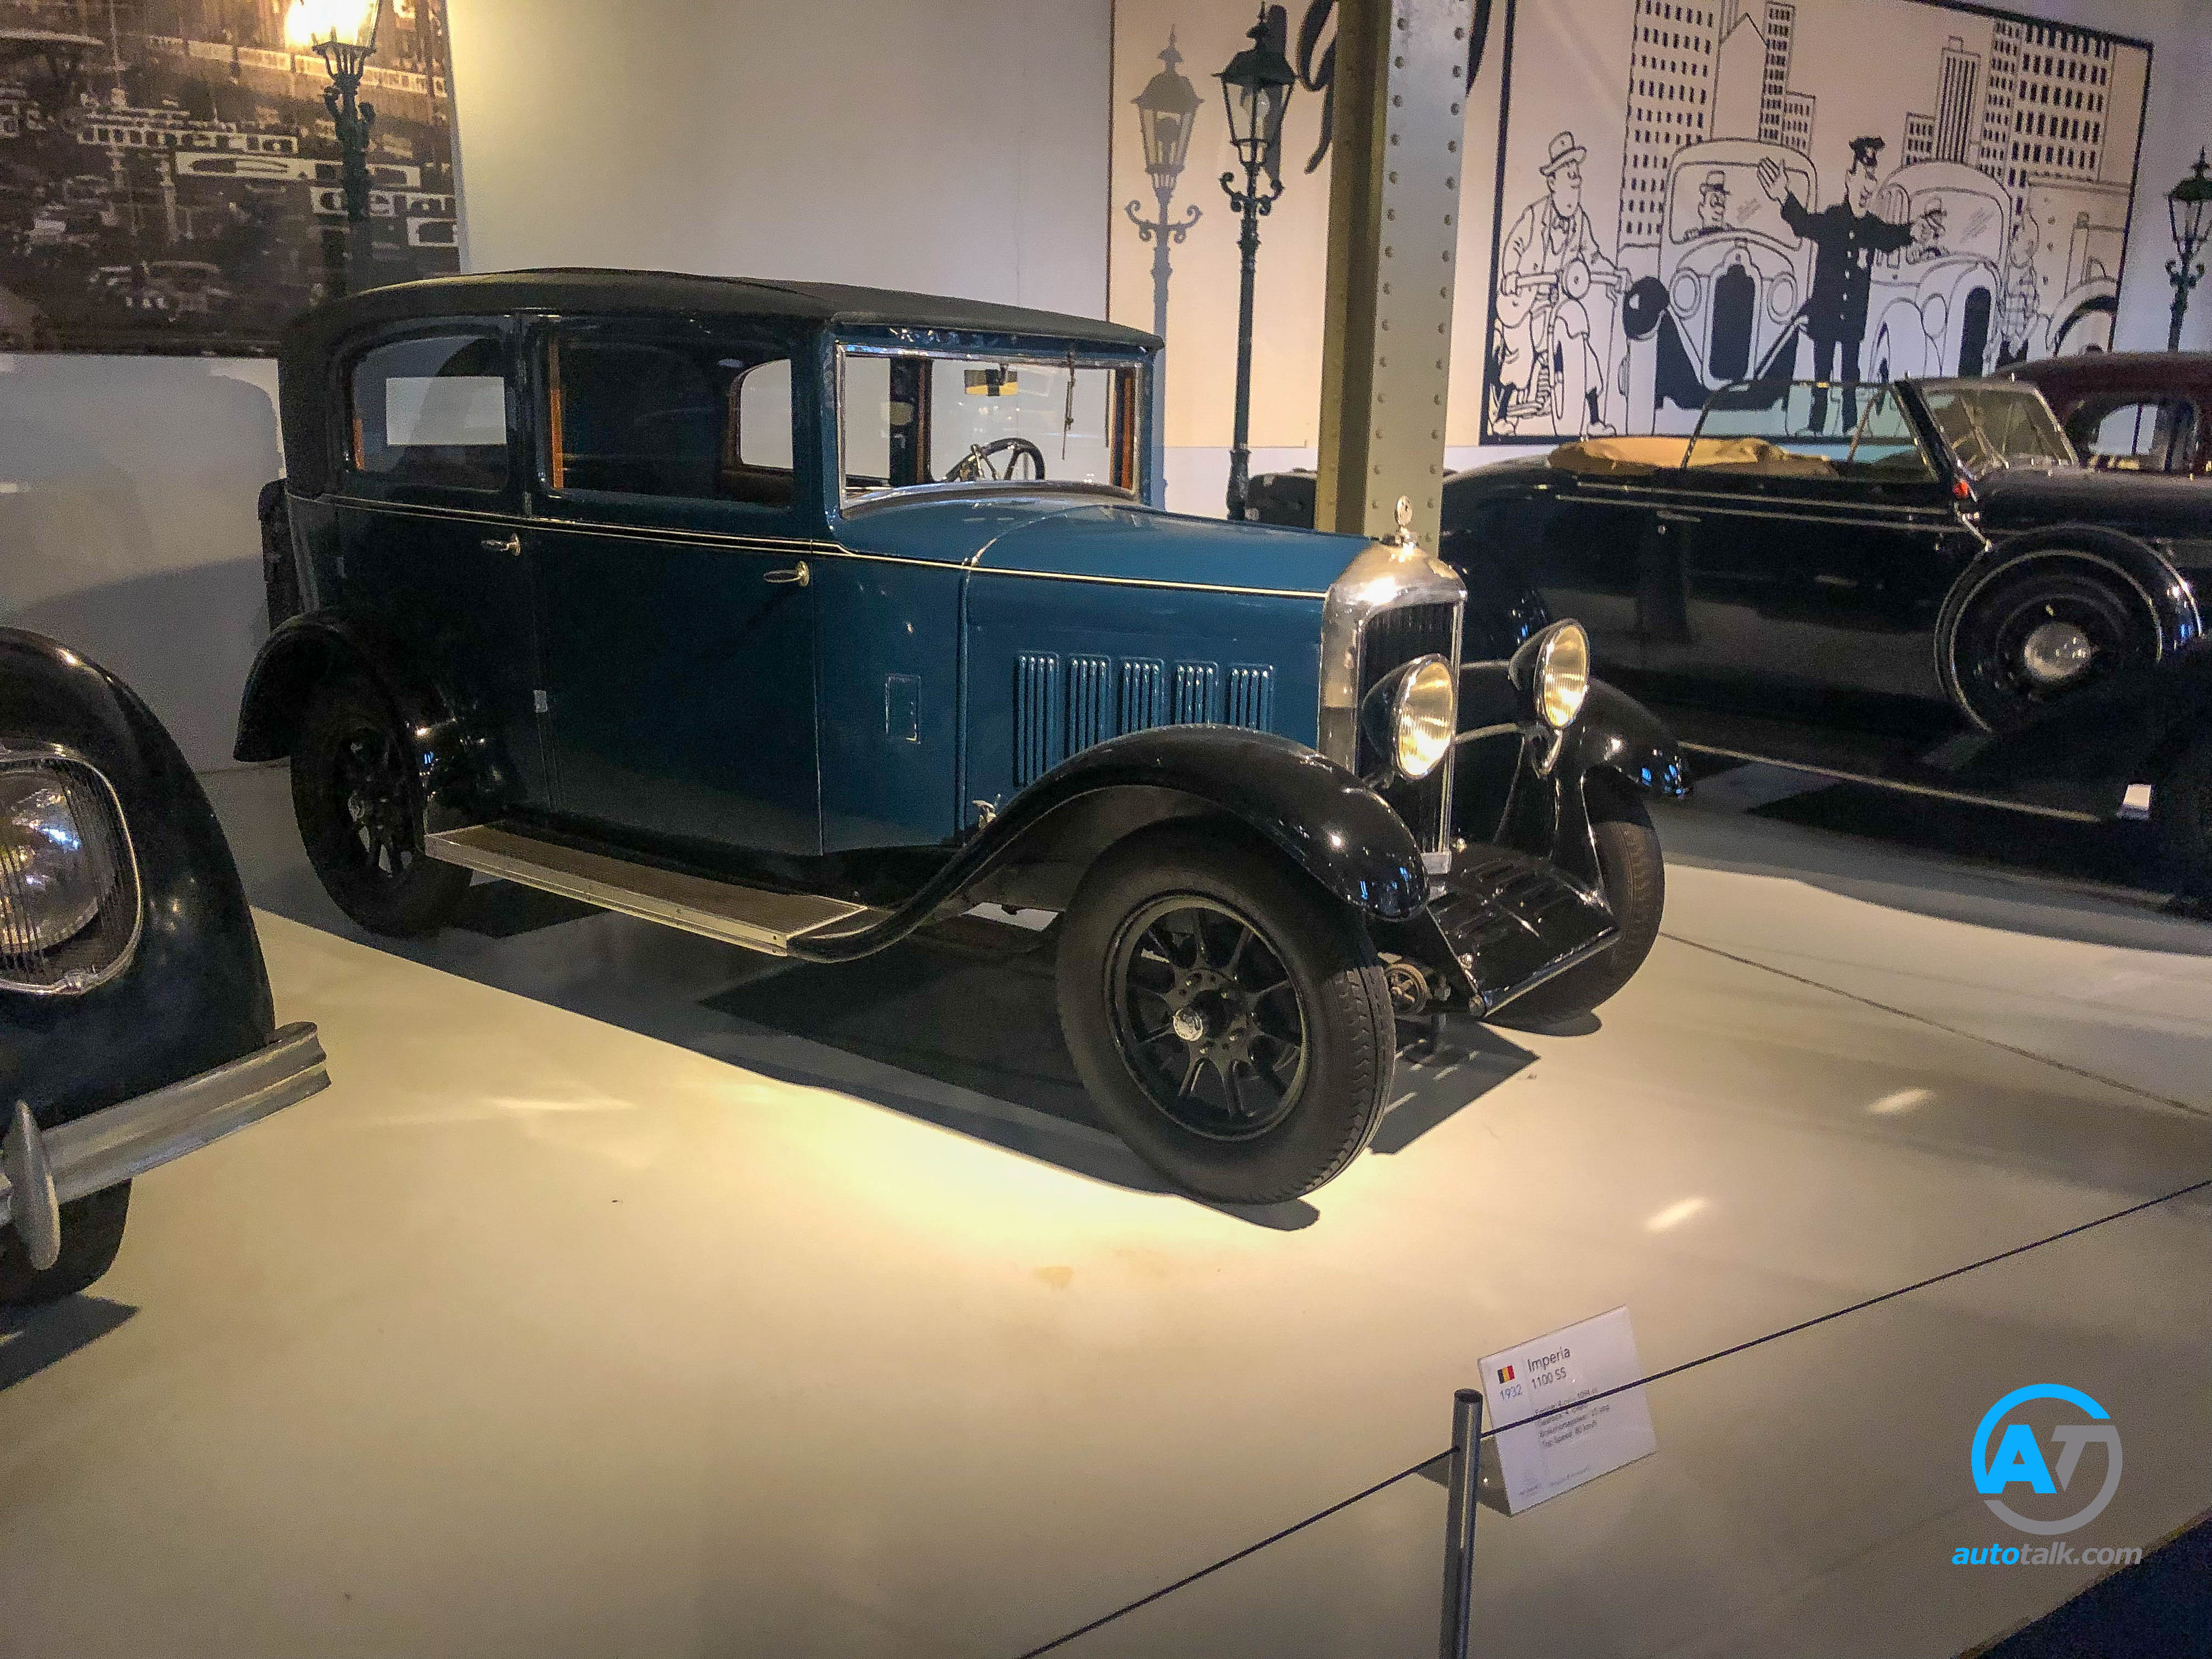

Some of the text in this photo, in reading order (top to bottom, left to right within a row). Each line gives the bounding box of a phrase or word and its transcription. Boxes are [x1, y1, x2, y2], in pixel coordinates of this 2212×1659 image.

[1527, 1346, 1571, 1372] Imperia
[1532, 1366, 1567, 1389] 1100 SS
[1500, 1384, 1523, 1400] 1932
